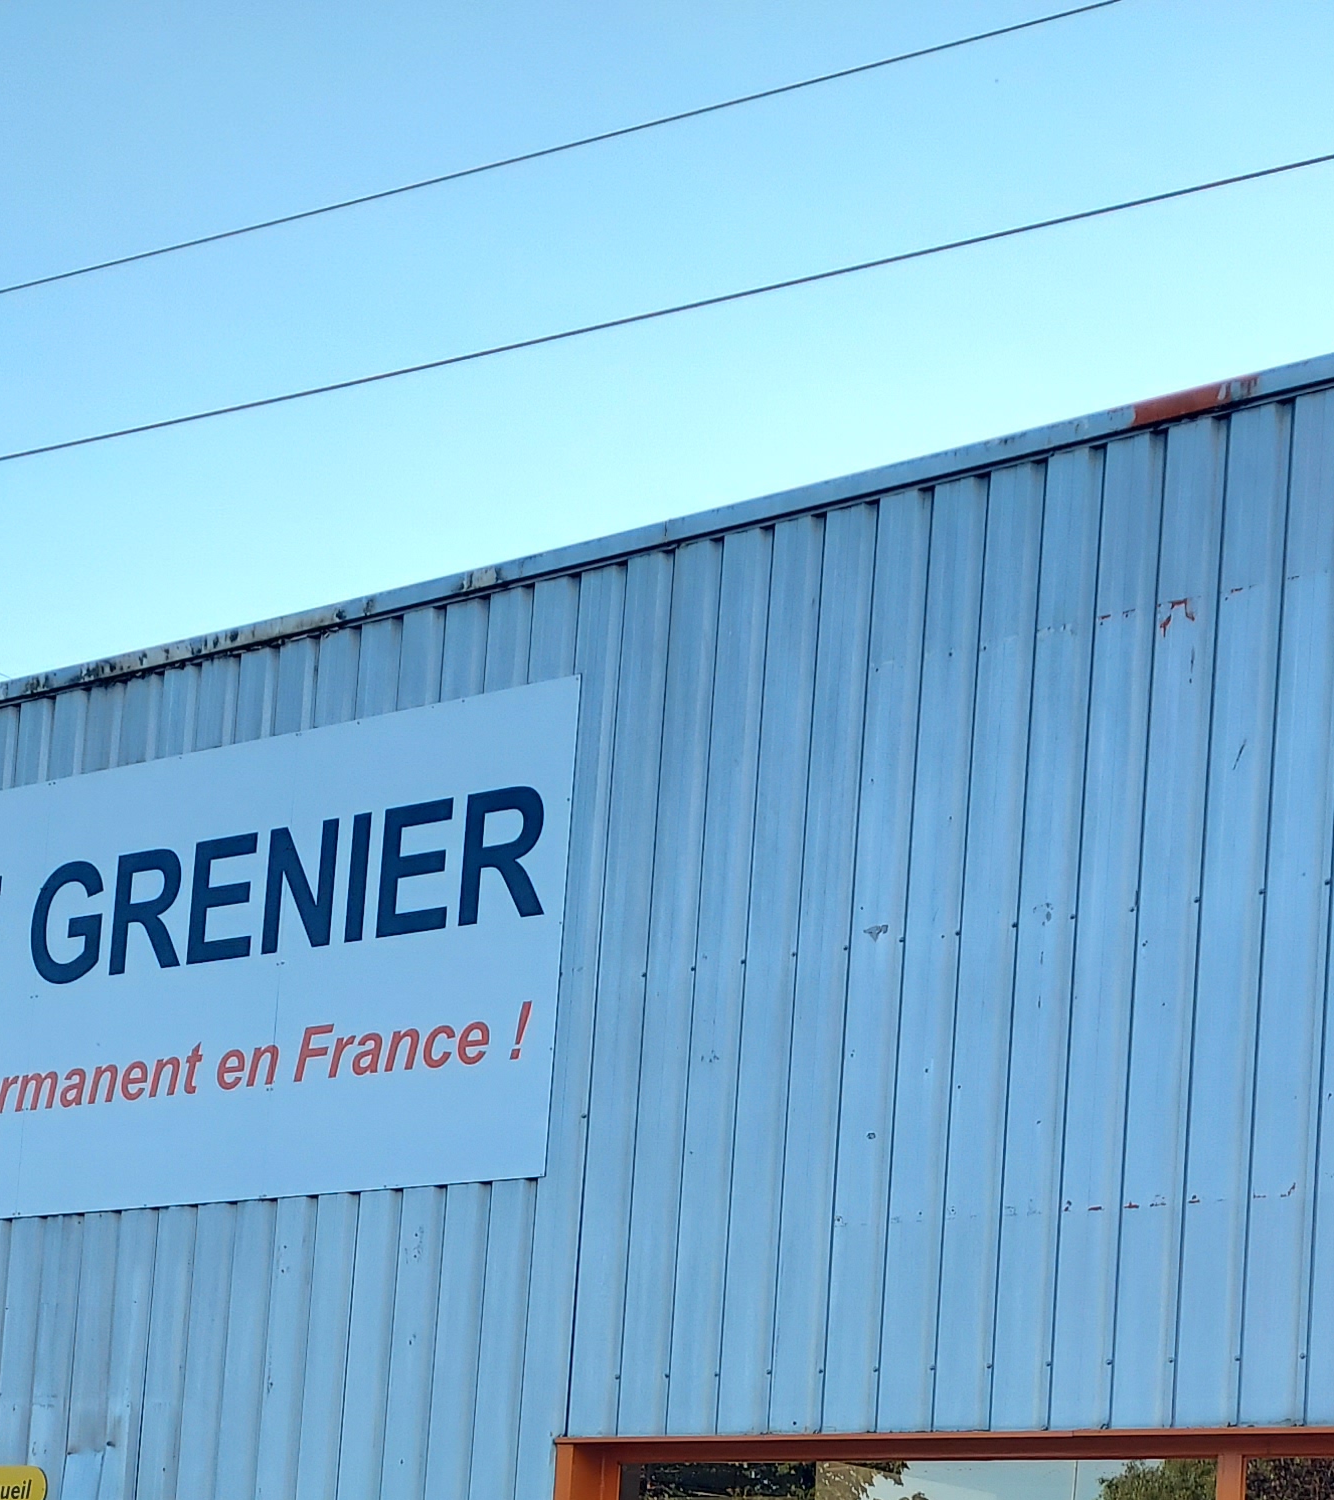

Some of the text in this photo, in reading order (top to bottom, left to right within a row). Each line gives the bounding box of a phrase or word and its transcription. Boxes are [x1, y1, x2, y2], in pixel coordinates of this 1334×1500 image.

[30, 786, 545, 985] GRENIER
[217, 1043, 280, 1092] en
[293, 1020, 491, 1082] France
[509, 1001, 533, 1061] !
